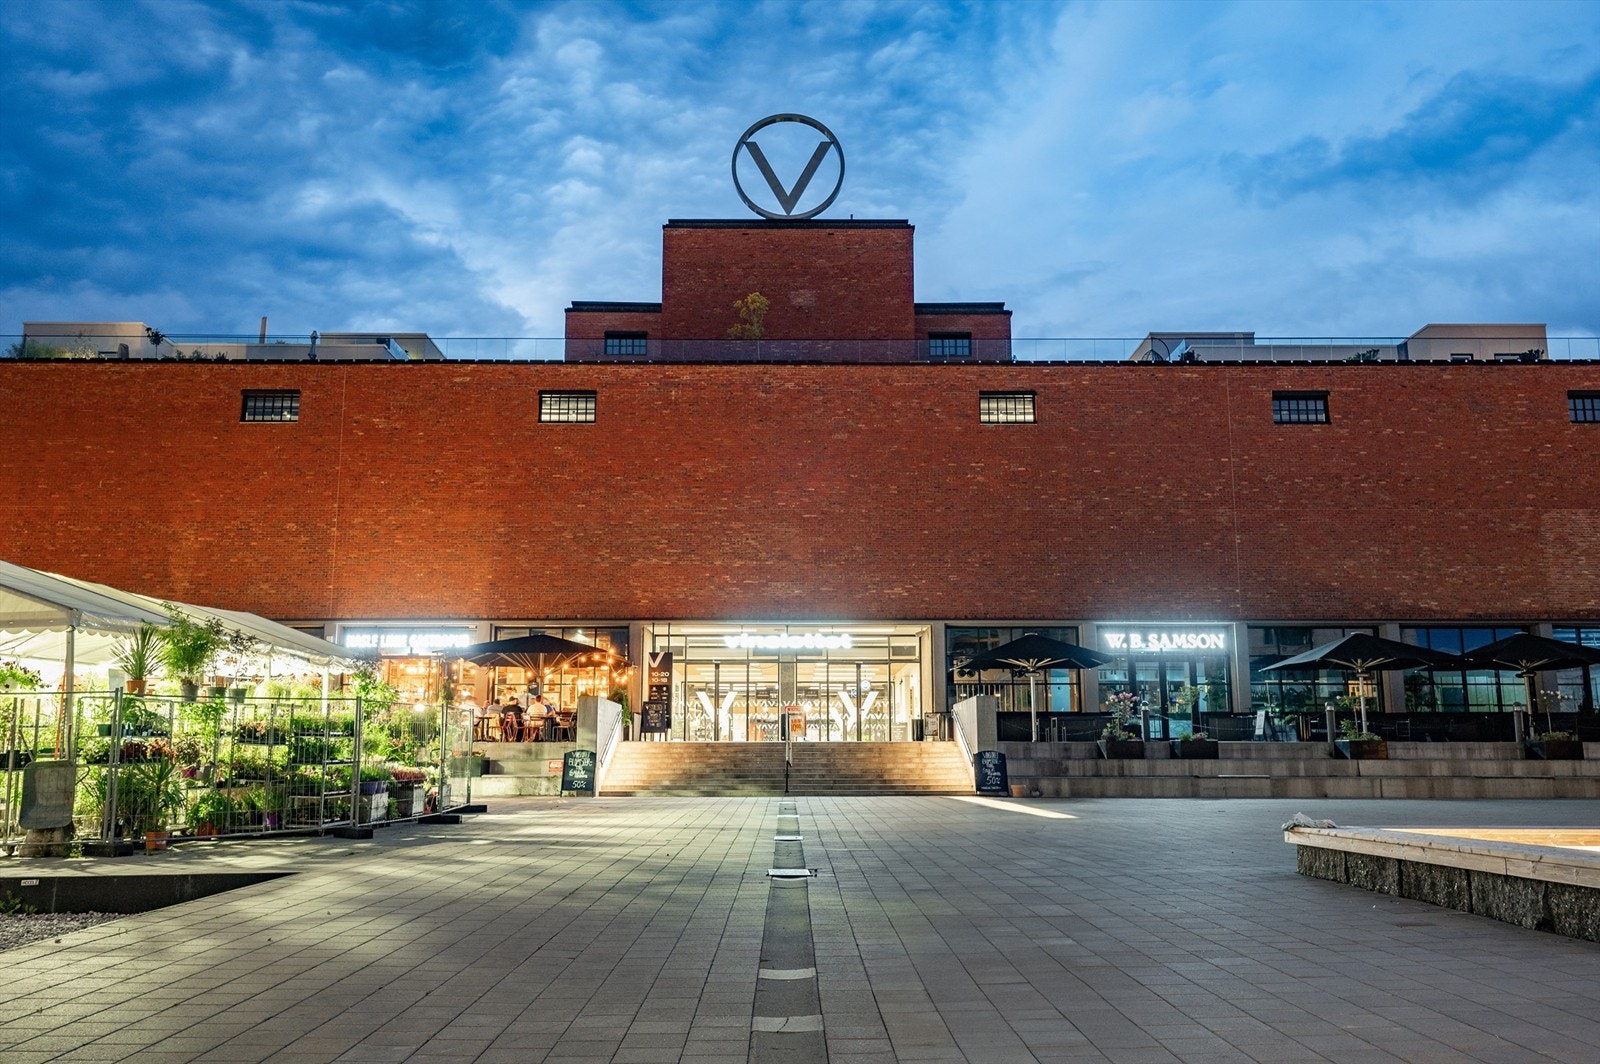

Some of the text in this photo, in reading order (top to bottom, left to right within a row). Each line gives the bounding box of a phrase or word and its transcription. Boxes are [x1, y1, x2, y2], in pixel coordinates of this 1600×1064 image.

[1105, 633, 1225, 650] W. B. SAMSON
[648, 652, 665, 668] V
[572, 780, 587, 789] 50%
